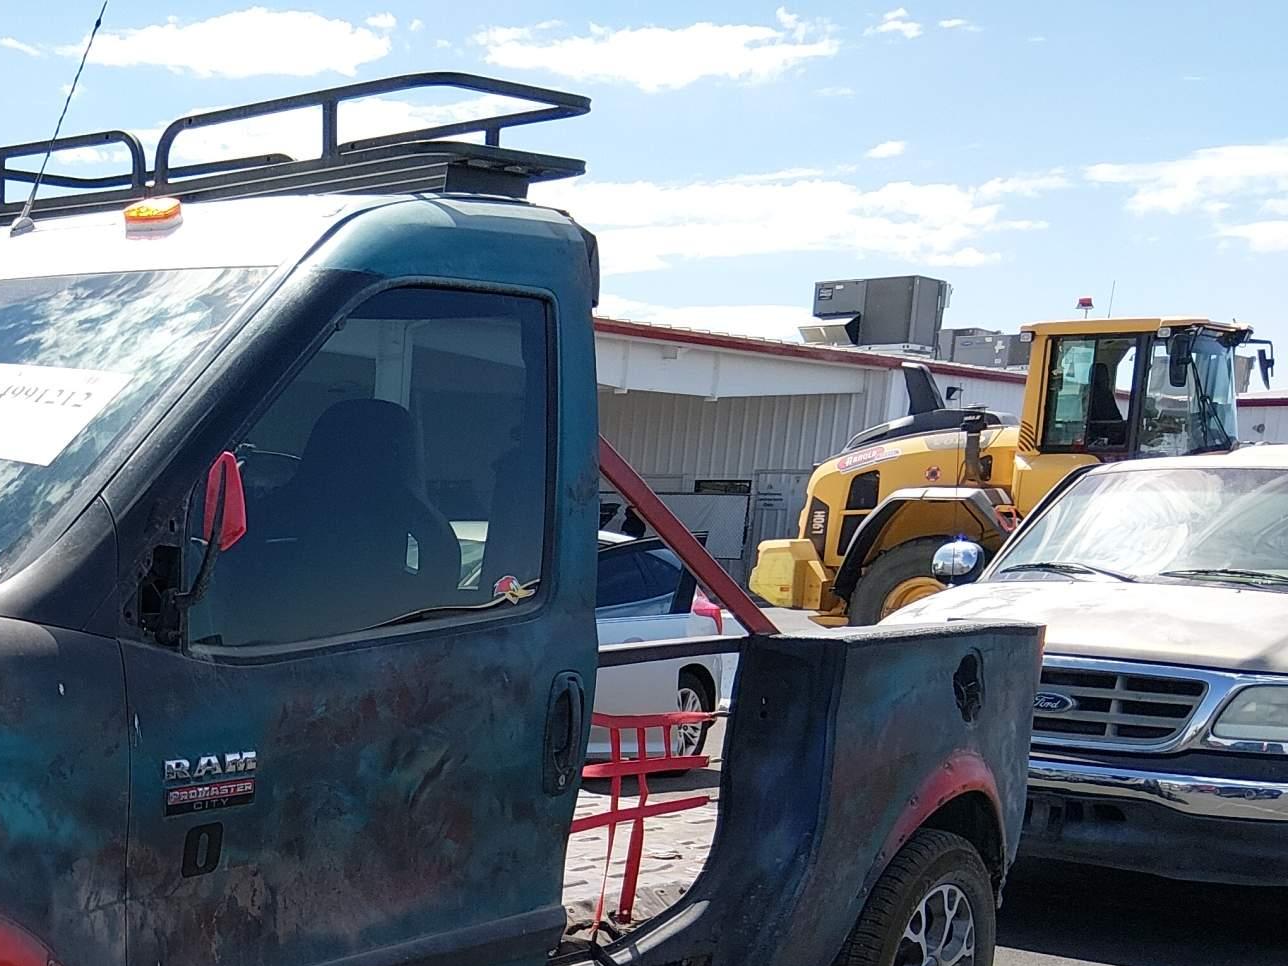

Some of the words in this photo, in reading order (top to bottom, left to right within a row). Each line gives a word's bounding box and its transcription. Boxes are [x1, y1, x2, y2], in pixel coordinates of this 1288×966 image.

[811, 510, 826, 534] L90H
[1034, 696, 1061, 708] Ford
[165, 751, 257, 780] RAM
[193, 798, 230, 810] CITY
